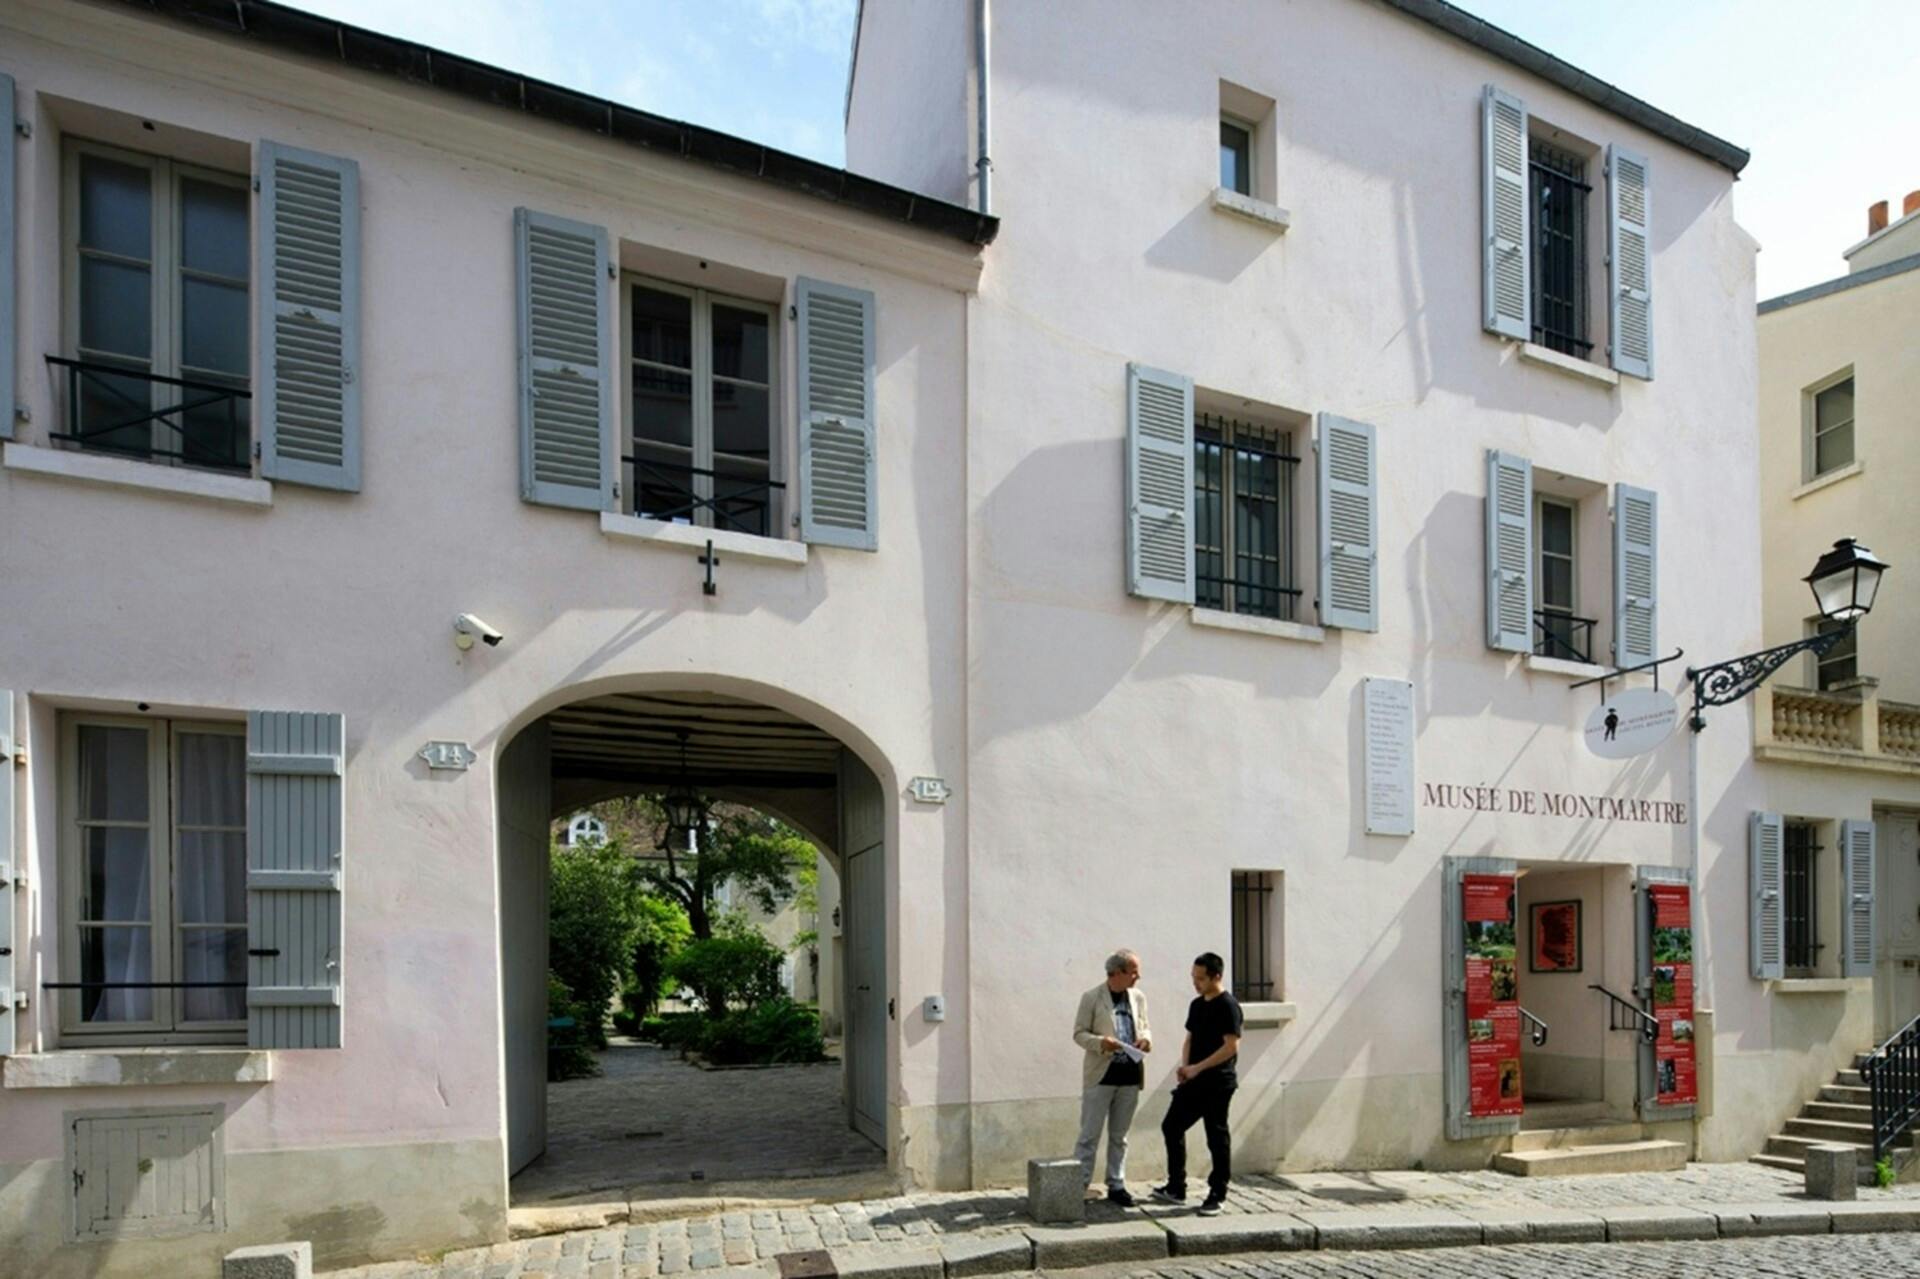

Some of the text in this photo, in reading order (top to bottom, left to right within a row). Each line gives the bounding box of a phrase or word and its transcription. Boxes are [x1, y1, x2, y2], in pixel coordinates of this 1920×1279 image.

[438, 744, 462, 764] 14
[1423, 781, 1502, 813] MUSÉE
[1508, 790, 1536, 815] DE
[1541, 792, 1688, 824] MONTMARTRE
